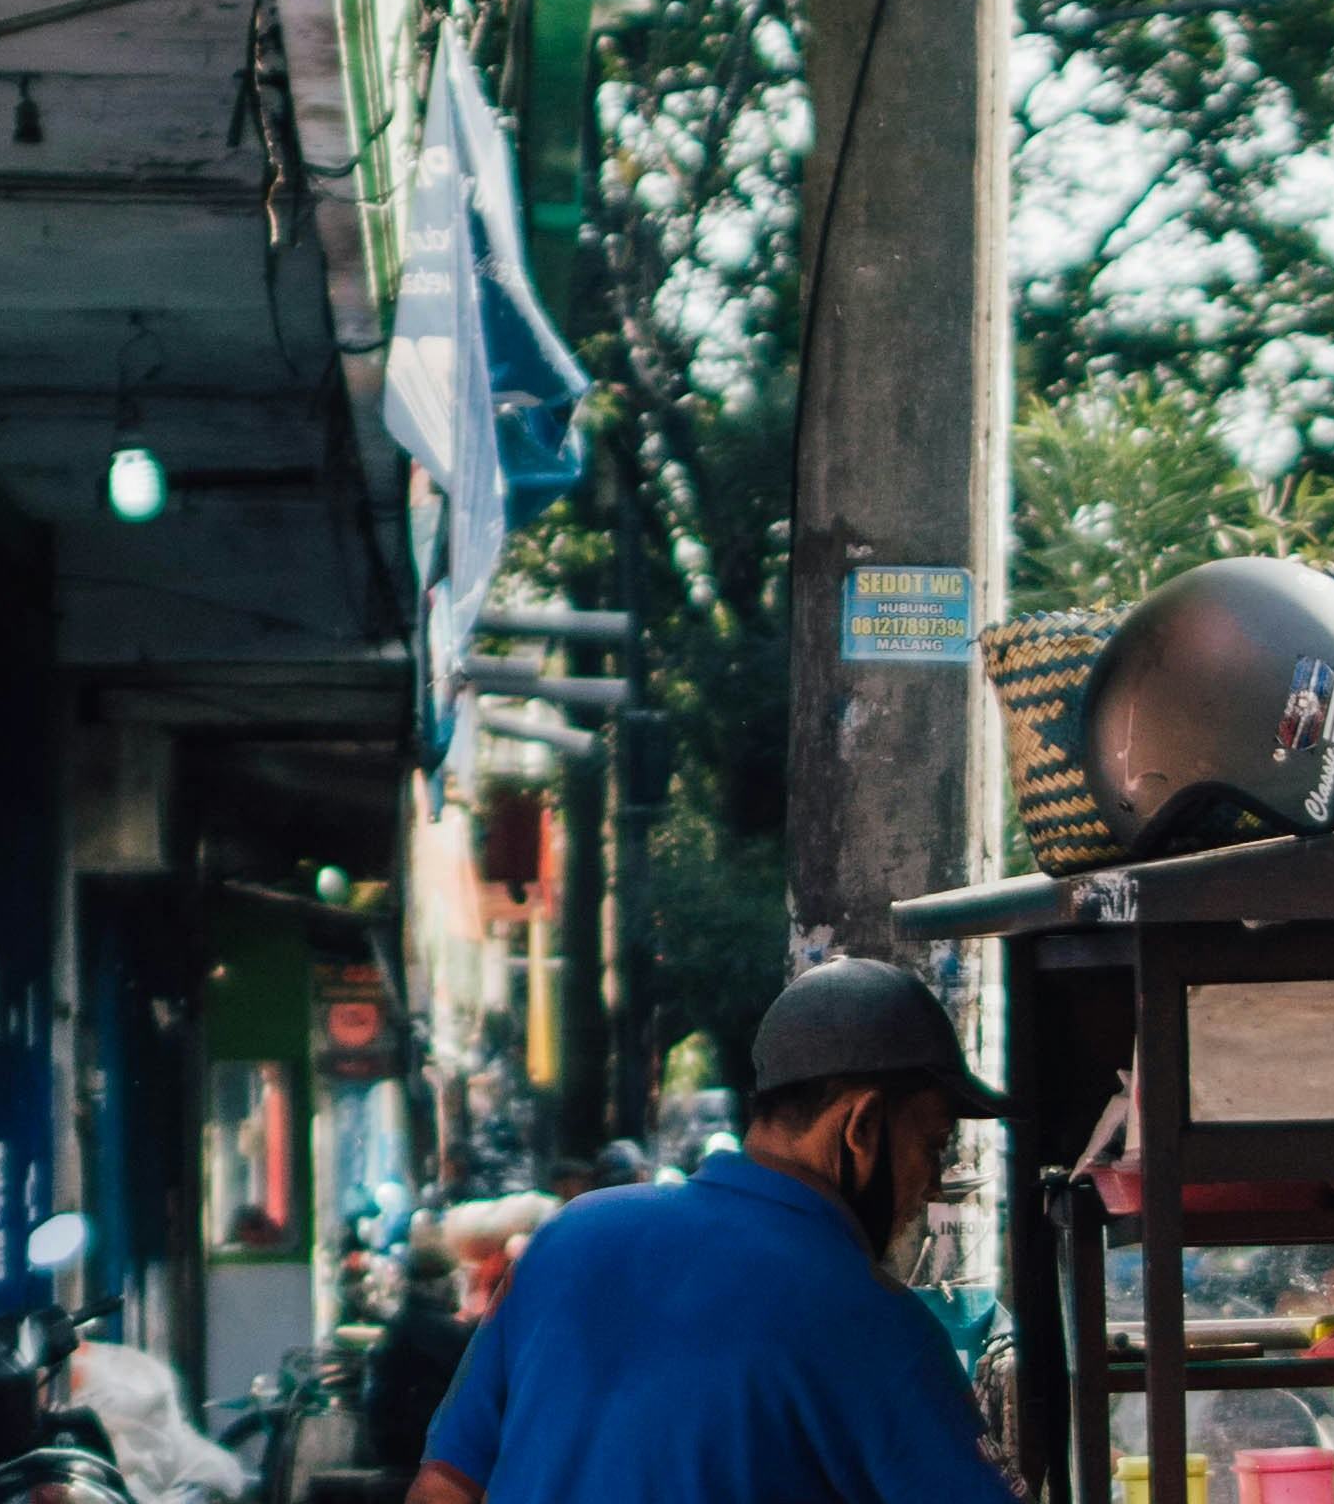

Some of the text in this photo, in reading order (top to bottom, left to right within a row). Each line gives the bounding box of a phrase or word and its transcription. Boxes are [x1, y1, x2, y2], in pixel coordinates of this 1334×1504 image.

[856, 573, 963, 595] SEDOT WC
[877, 602, 943, 614] HUBUNGI
[851, 616, 965, 636] 081217897394
[876, 638, 943, 651] MALANG
